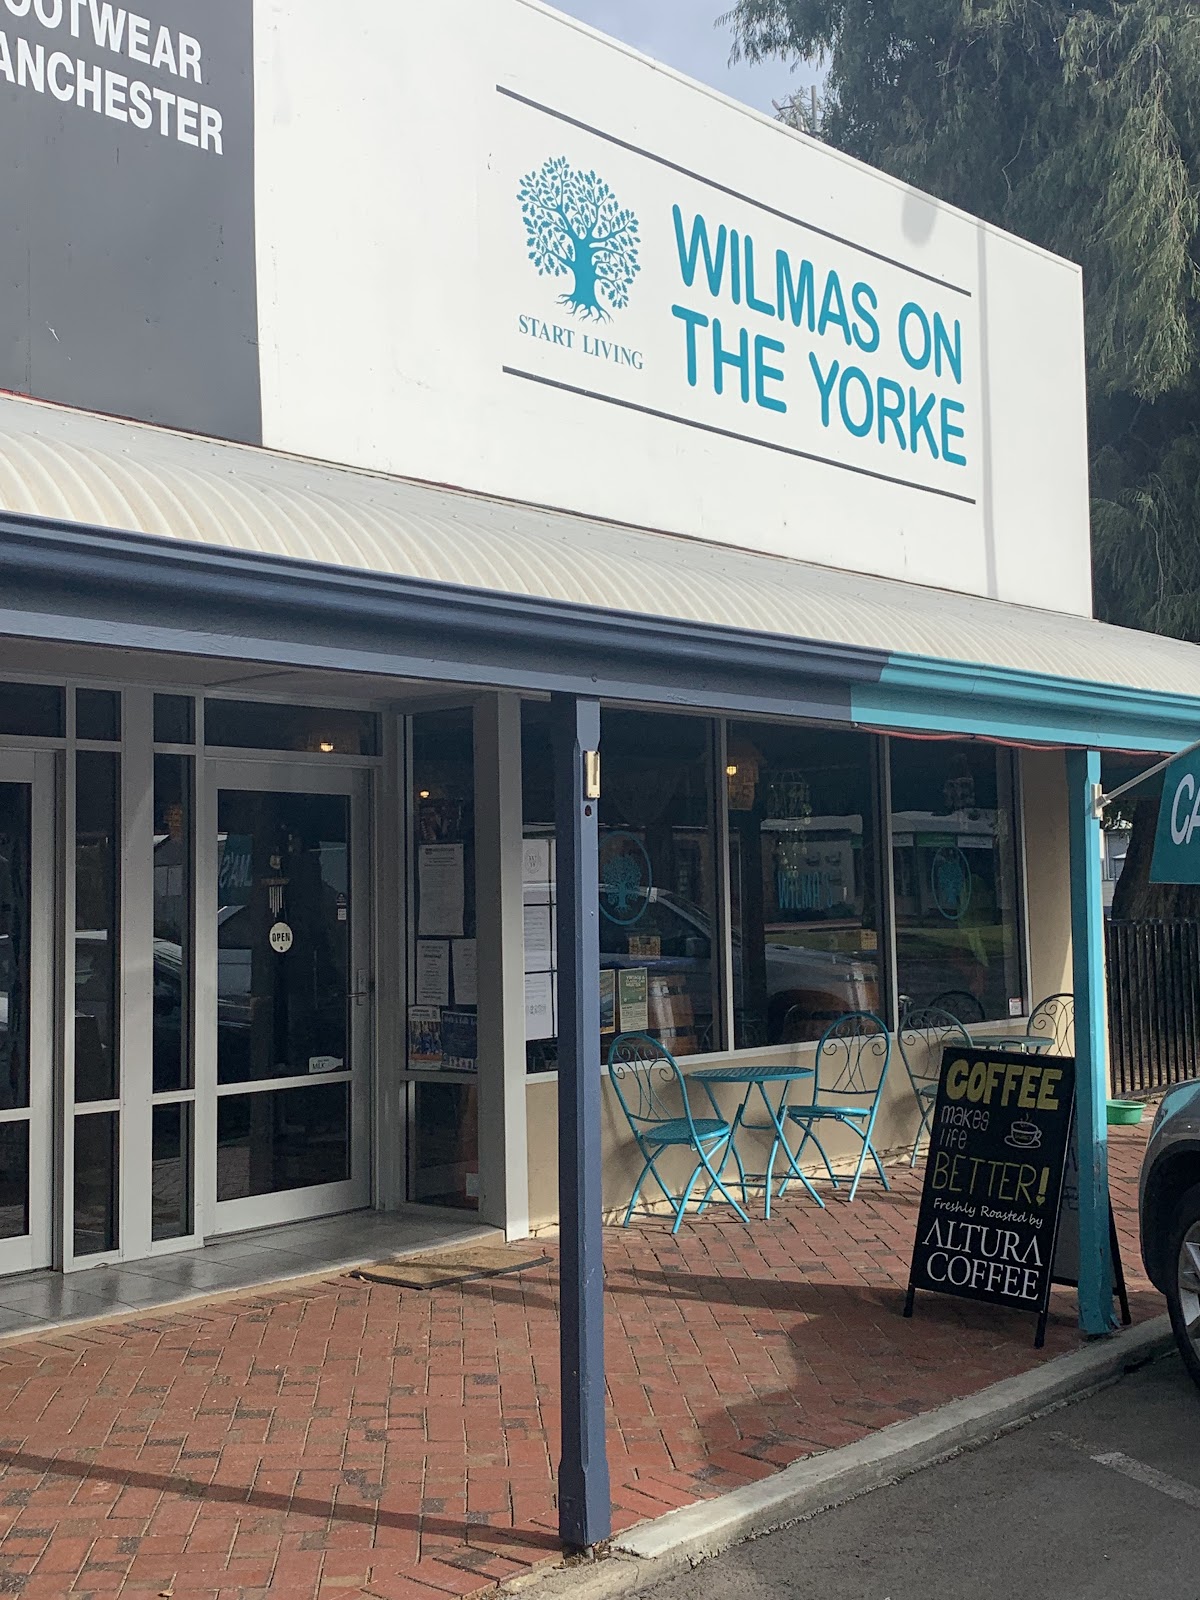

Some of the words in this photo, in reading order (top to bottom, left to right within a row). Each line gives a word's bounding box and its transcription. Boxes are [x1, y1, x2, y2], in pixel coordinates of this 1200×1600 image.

[672, 204, 880, 352] WILMAS
[898, 302, 962, 384] ON
[519, 314, 575, 348] START
[582, 334, 644, 370] LIVING
[672, 304, 787, 413] THE
[808, 352, 967, 466] YORKE
[271, 932, 291, 942] OPEN
[946, 1058, 1063, 1110] COFFEE
[939, 1128, 967, 1149] life
[941, 1105, 990, 1132] makes
[932, 1151, 1050, 1206] BETTER!
[934, 1197, 976, 1217] Freshly
[981, 1205, 1028, 1223] Roasted
[1028, 1213, 1043, 1228] by
[922, 1218, 1043, 1266] ALTURA
[927, 1251, 1039, 1300] COFFEE
